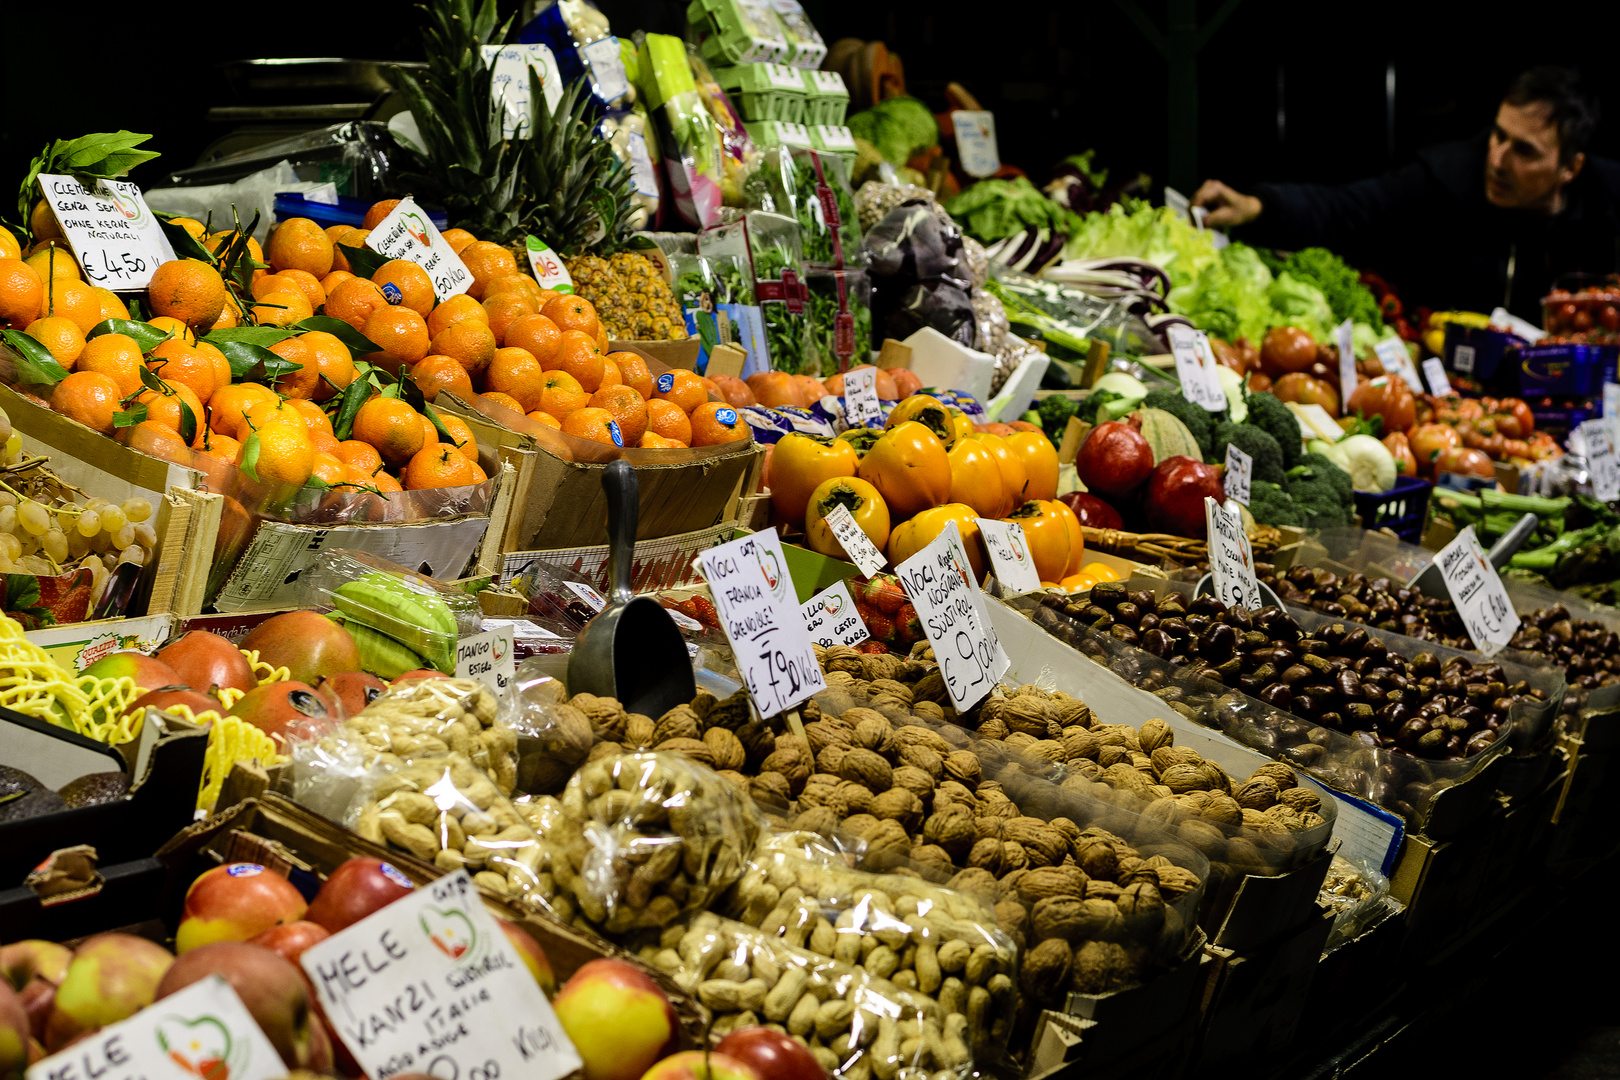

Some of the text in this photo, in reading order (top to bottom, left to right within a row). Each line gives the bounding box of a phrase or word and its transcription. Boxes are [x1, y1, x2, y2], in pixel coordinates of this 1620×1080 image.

[57, 201, 118, 213] SENZA SEMI
[64, 219, 130, 229] OHNE KERNE
[88, 231, 141, 242] NATURALI
[102, 249, 146, 280] 4,50
[706, 555, 740, 582] NOCI
[725, 585, 764, 610] FRANCIA
[834, 617, 857, 636] CESTO
[843, 628, 868, 647] KORB
[457, 642, 490, 664] MANGO
[945, 657, 967, 703] €
[317, 929, 407, 1004] MELE
[346, 980, 438, 1050] KANZI
[424, 988, 491, 1037] ITALIA
